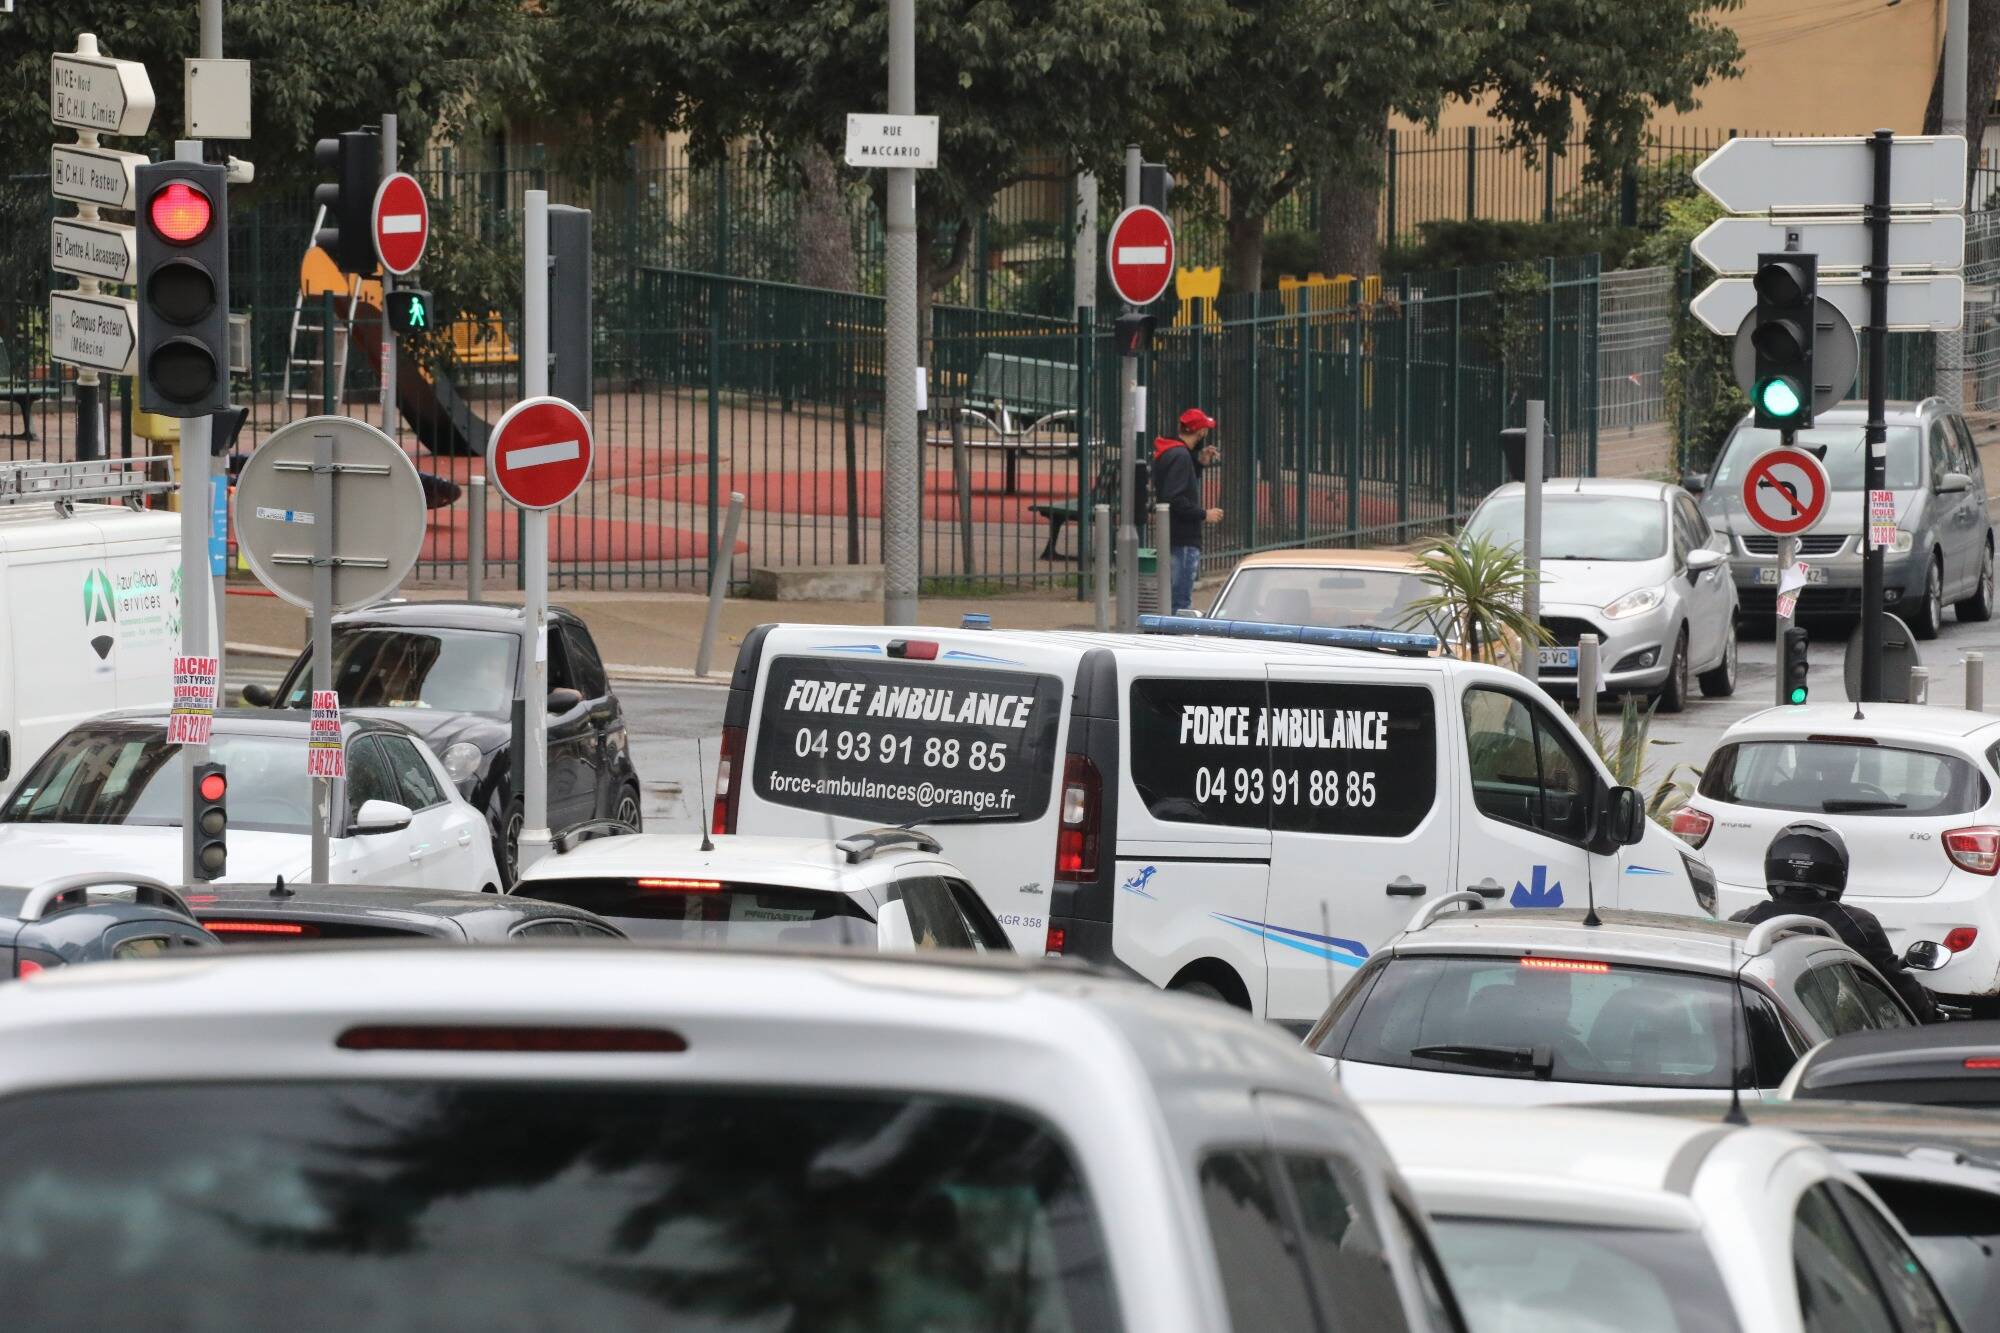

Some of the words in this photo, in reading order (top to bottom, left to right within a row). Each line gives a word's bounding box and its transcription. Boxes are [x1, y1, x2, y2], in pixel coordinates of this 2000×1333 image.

[92, 102, 116, 124] Cimiez
[883, 126, 903, 136] RUE
[861, 145, 921, 157] MACCARIO
[91, 169, 118, 192] Pasteur
[64, 237, 84, 259] Centre
[92, 243, 126, 271] Lacassagne
[71, 310, 96, 334] Campus
[97, 315, 123, 337] Pasteur
[133, 568, 160, 589] Global
[190, 676, 212, 685] TYPES
[784, 679, 866, 716] FORCE
[866, 685, 1035, 729] AMBULANCE
[177, 715, 187, 743] 46
[188, 715, 199, 743] 22
[1180, 705, 1250, 746] FORCE
[1255, 707, 1389, 750] AMBULANCE
[324, 749, 333, 776] 22
[795, 727, 829, 759] 04
[836, 730, 871, 762] 93
[879, 733, 913, 765] 91
[923, 737, 960, 769] 88
[968, 740, 1007, 773] 85
[769, 771, 1016, 812] force-ambulances@orange.fr
[1195, 766, 1228, 804] 04
[1234, 767, 1265, 805] 93
[1272, 768, 1299, 806] 91
[1309, 769, 1339, 807] 88
[1346, 770, 1376, 808] 85
[998, 914, 1020, 926] AGR
[1022, 917, 1042, 928] 358
